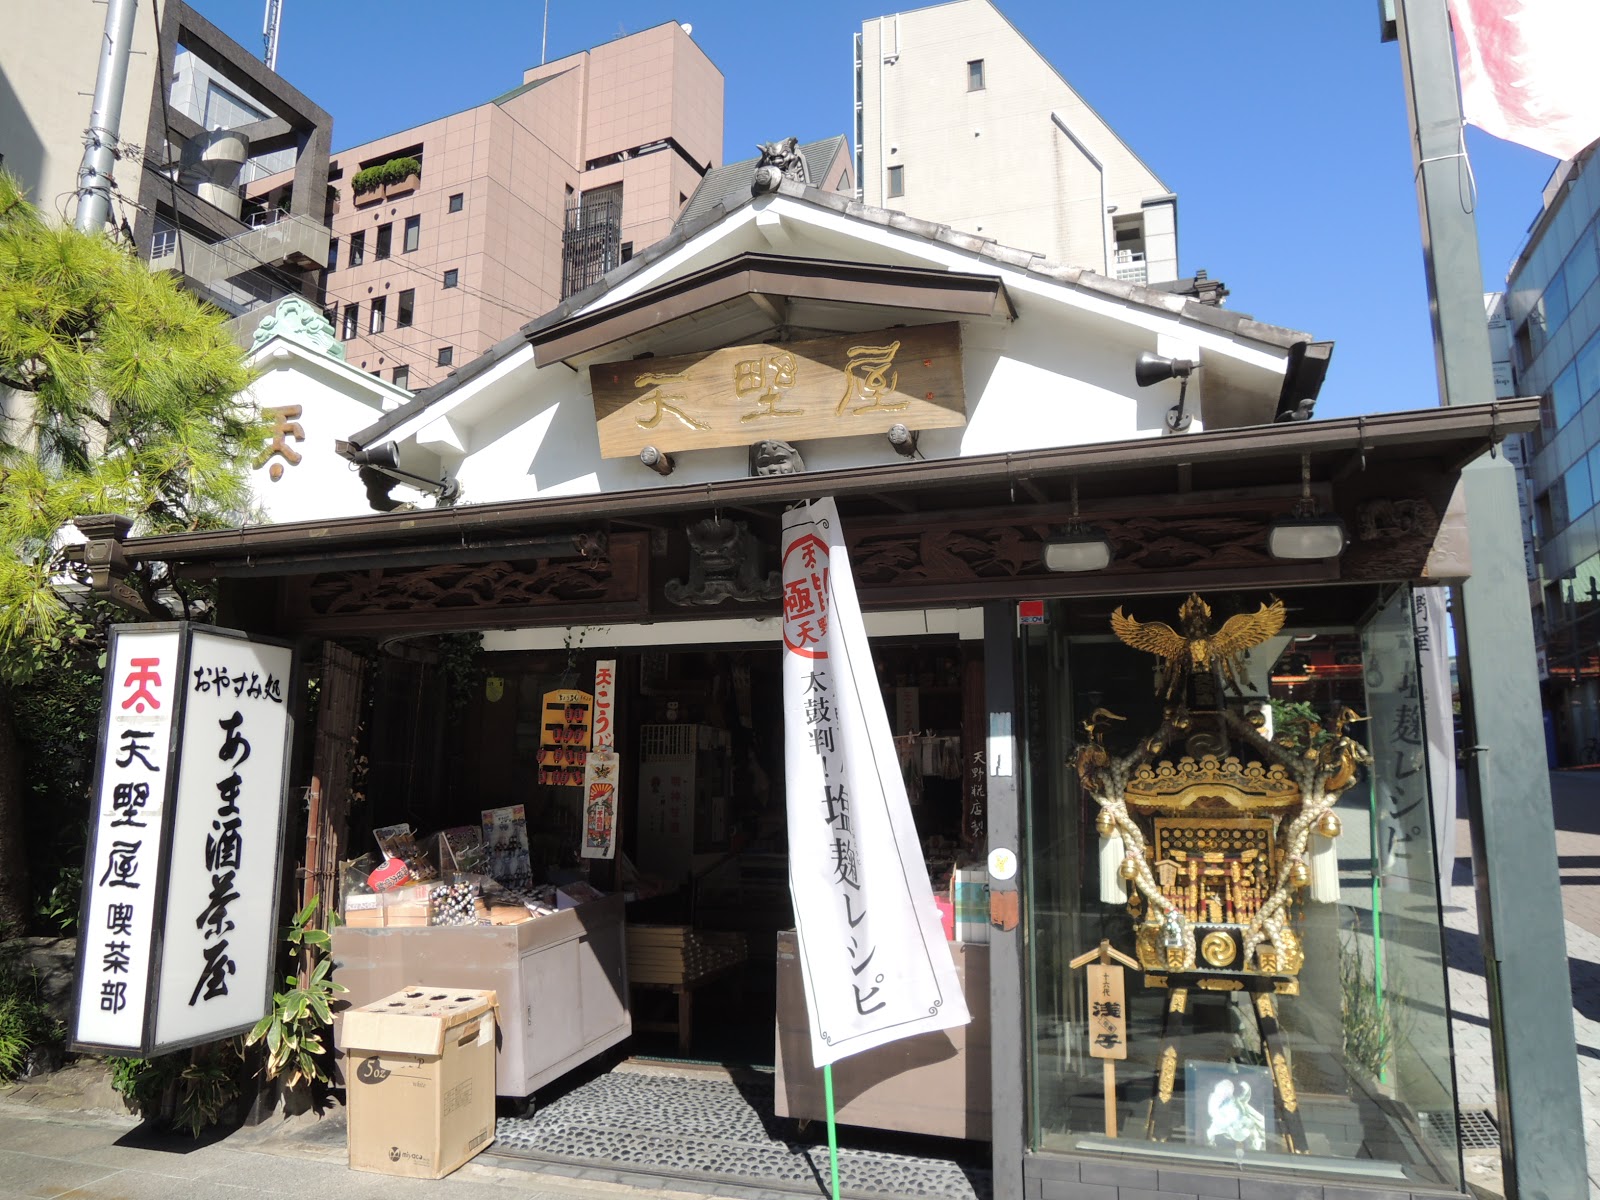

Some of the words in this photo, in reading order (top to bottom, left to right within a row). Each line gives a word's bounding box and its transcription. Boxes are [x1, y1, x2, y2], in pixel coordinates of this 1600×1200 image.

[193, 666, 283, 704] おやすみ処
[188, 711, 251, 1007] あま酒茶屋
[99, 903, 134, 1015] 喫茶部
